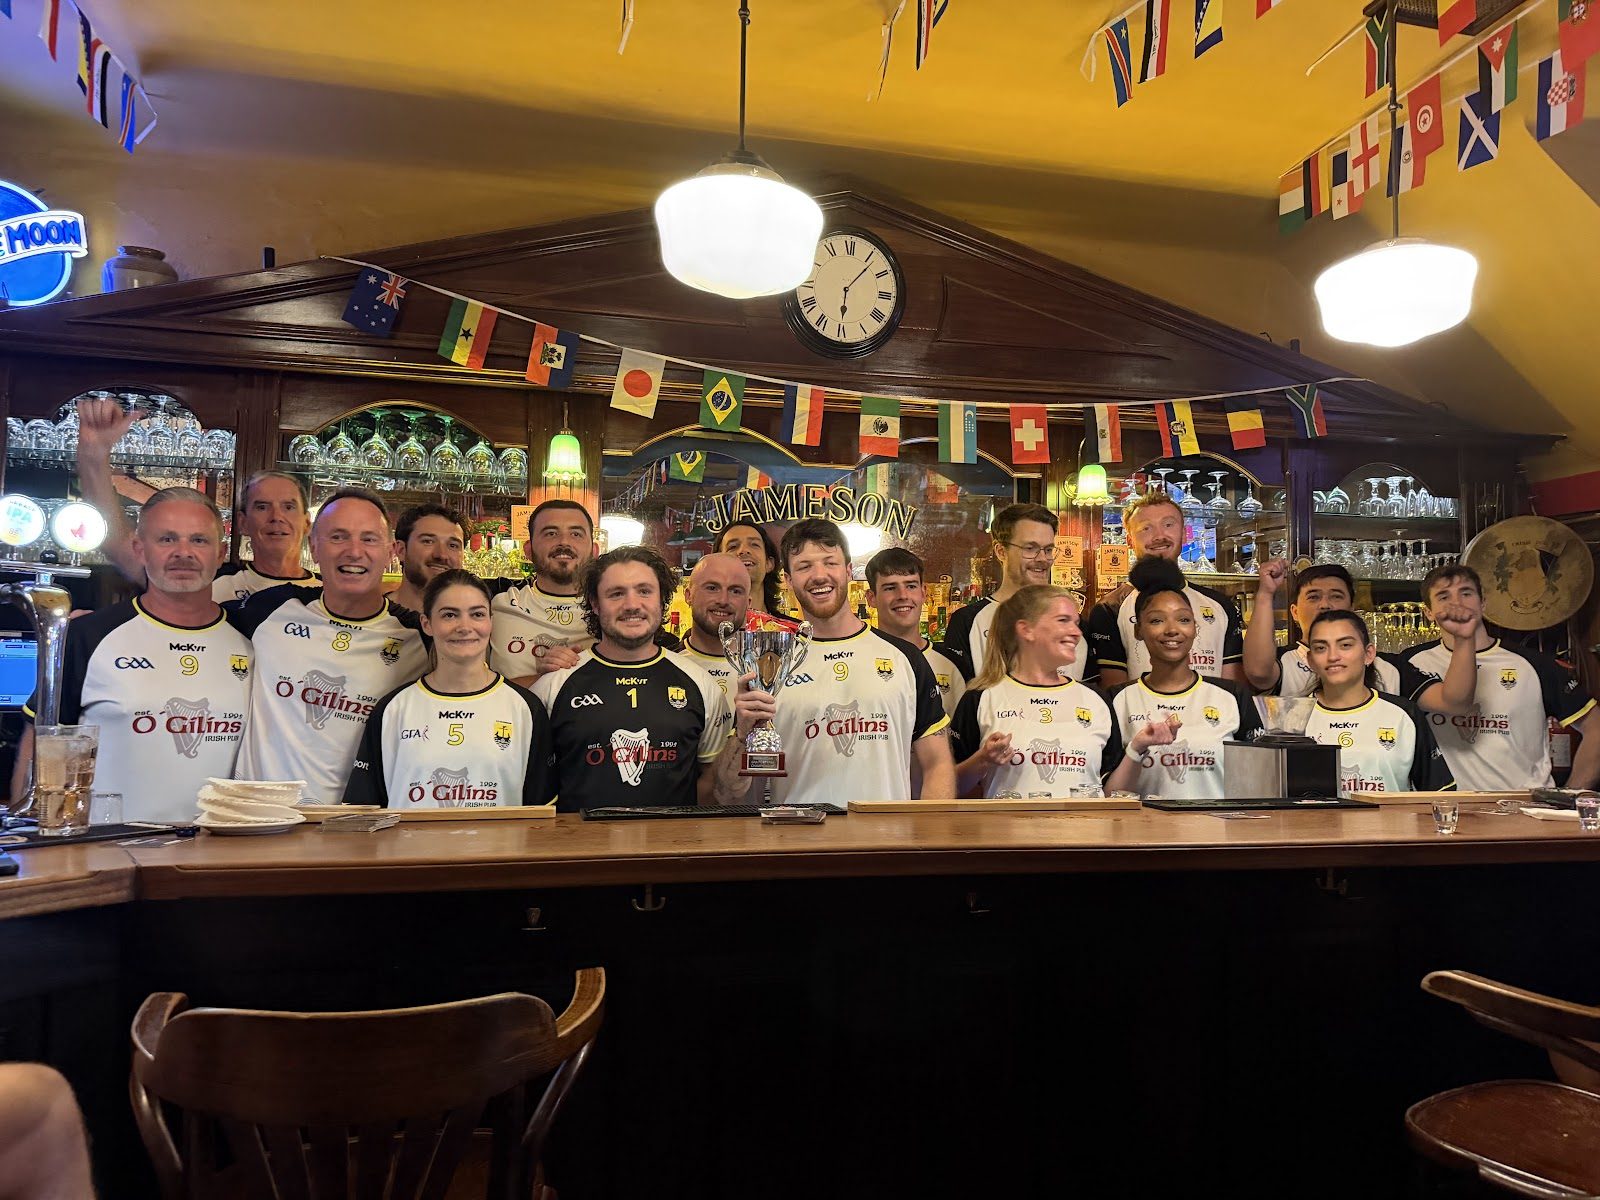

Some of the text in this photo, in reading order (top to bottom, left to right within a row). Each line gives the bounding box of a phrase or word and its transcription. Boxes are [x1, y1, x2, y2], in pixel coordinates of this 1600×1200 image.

[5, 220, 81, 253] MOON
[706, 484, 919, 540] JAMESON
[544, 607, 574, 625] 20
[332, 631, 352, 651] 8
[180, 654, 199, 676] 9
[833, 661, 849, 682] 9
[626, 687, 638, 709] 1
[334, 711, 356, 722] IRISH
[1039, 707, 1053, 724] 3
[401, 729, 421, 740] GFA
[446, 723, 465, 746] 5
[1338, 732, 1354, 748] 6
